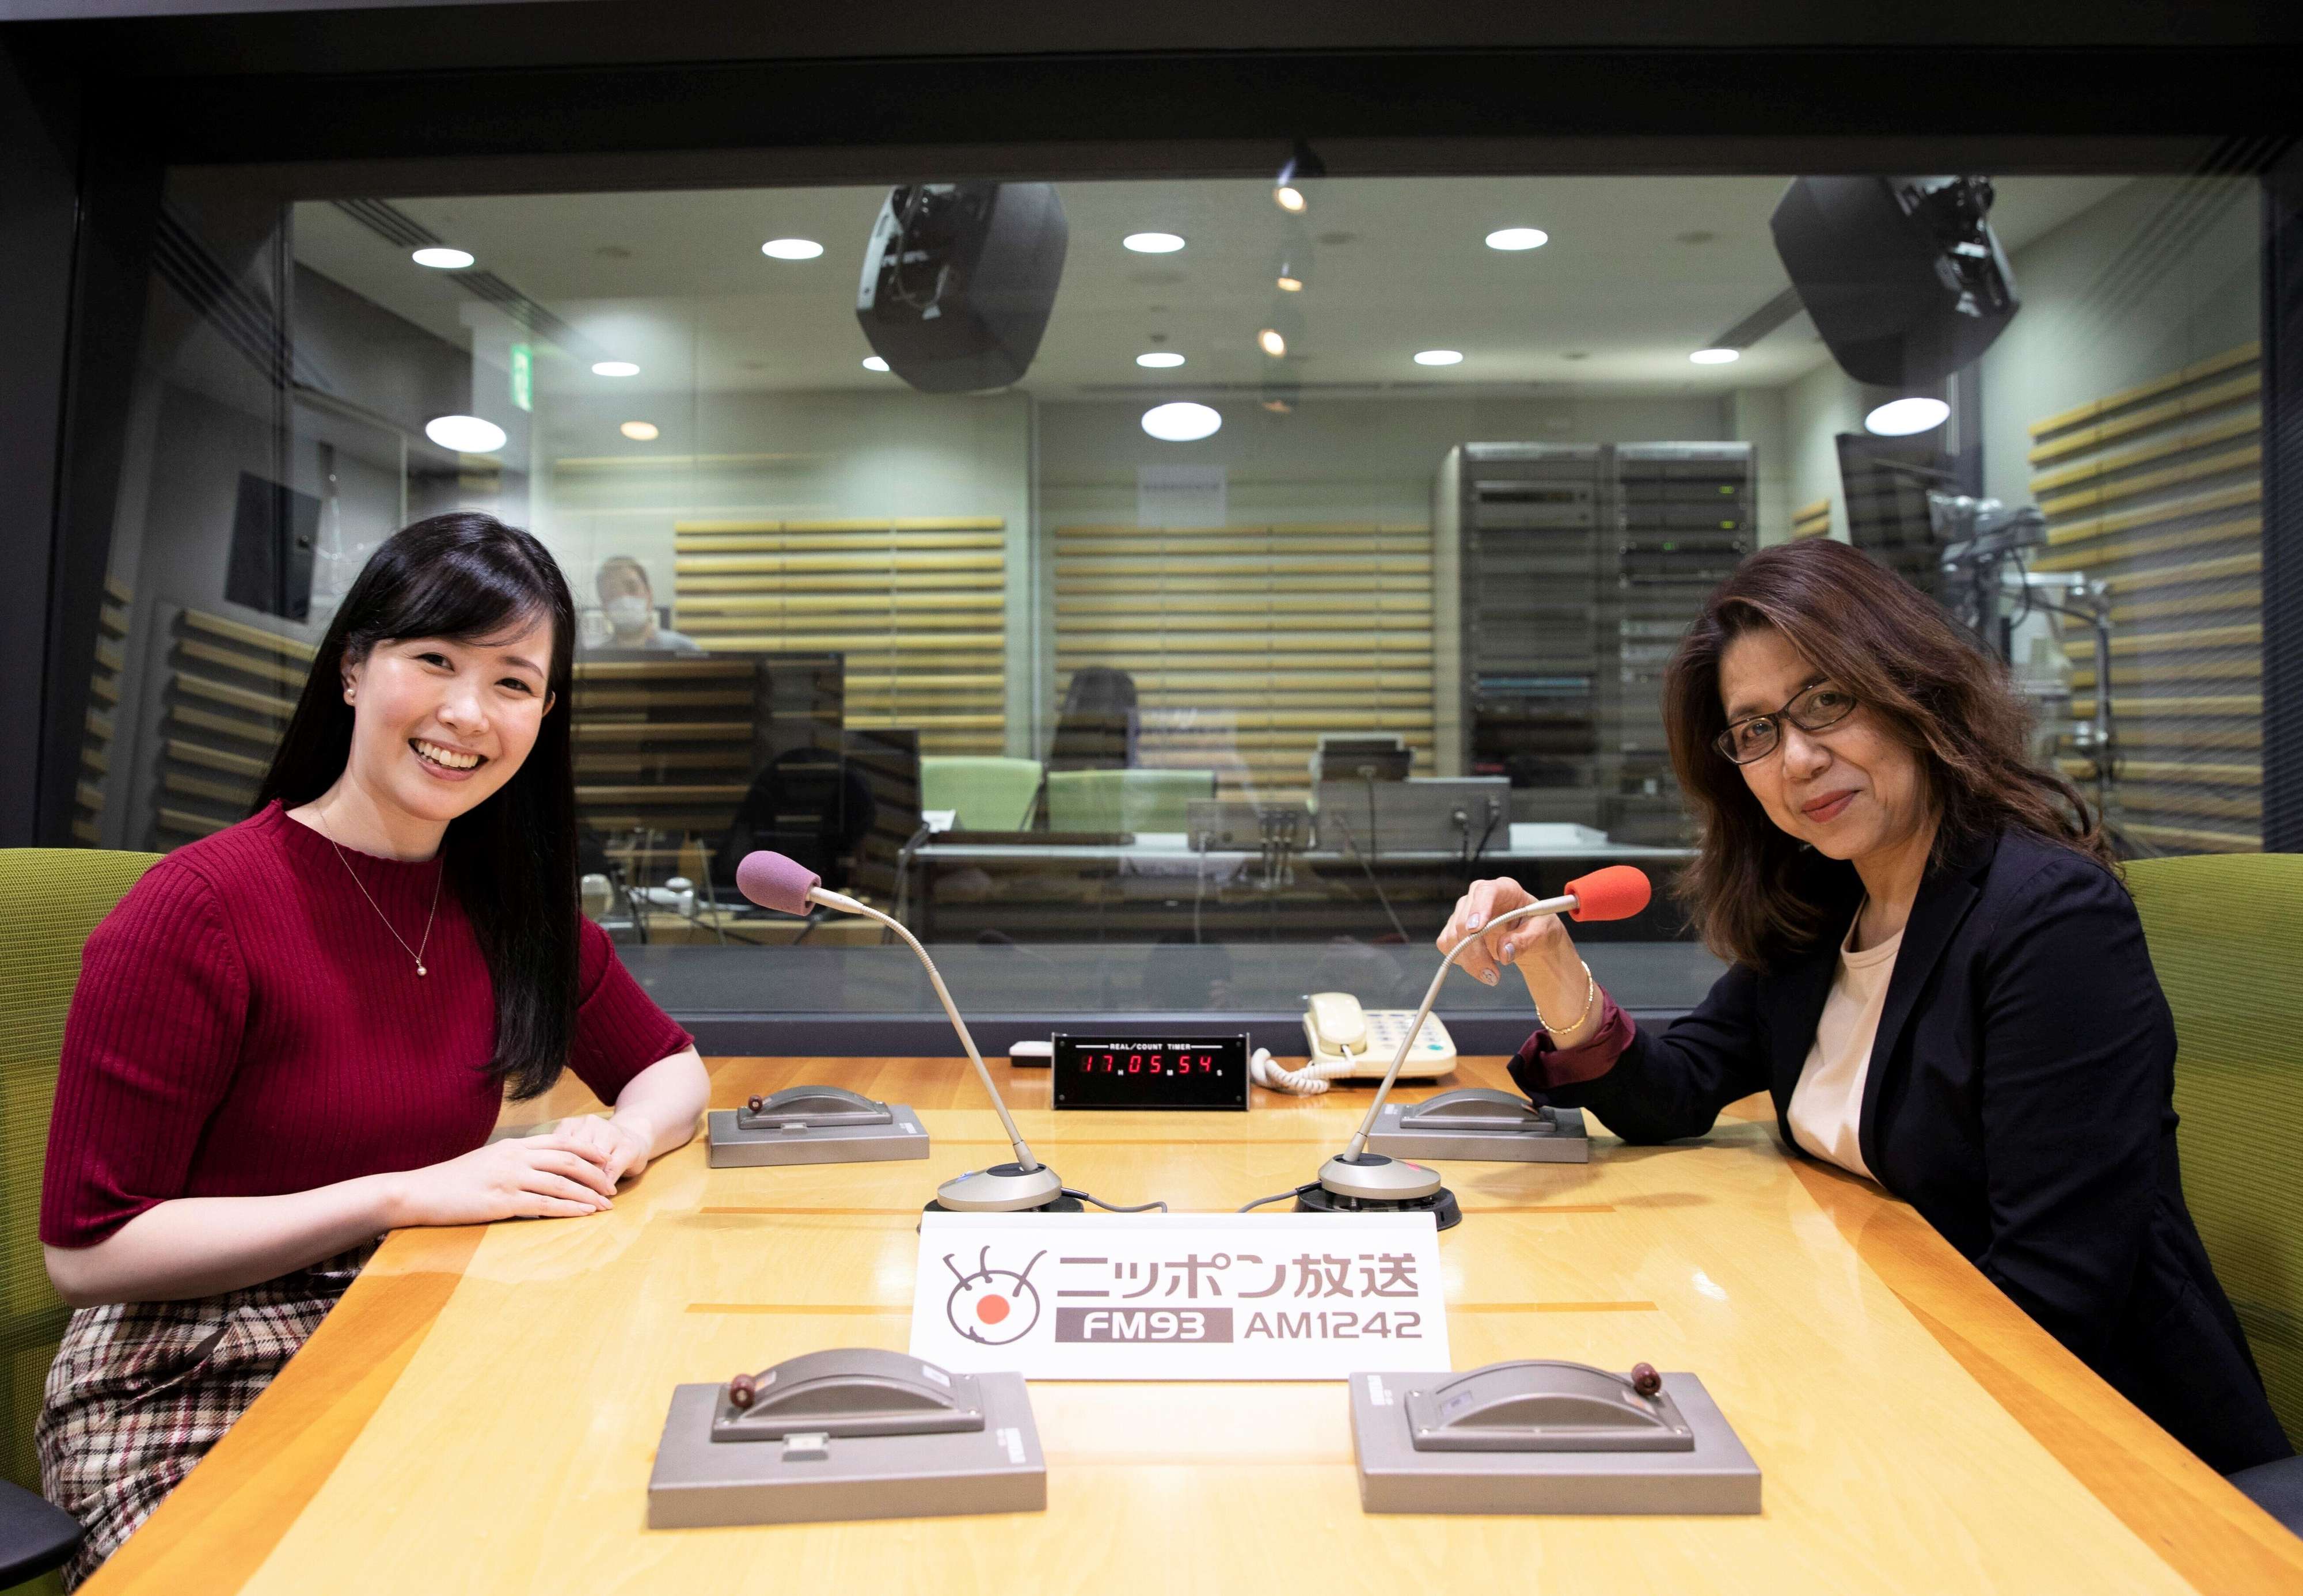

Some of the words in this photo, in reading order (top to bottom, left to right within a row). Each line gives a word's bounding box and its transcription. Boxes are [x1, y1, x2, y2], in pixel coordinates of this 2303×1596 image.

[1057, 1252, 1419, 1299] ニッポン放送
[1084, 1312, 1205, 1339] FM93
[1244, 1312, 1422, 1339] AM1242
